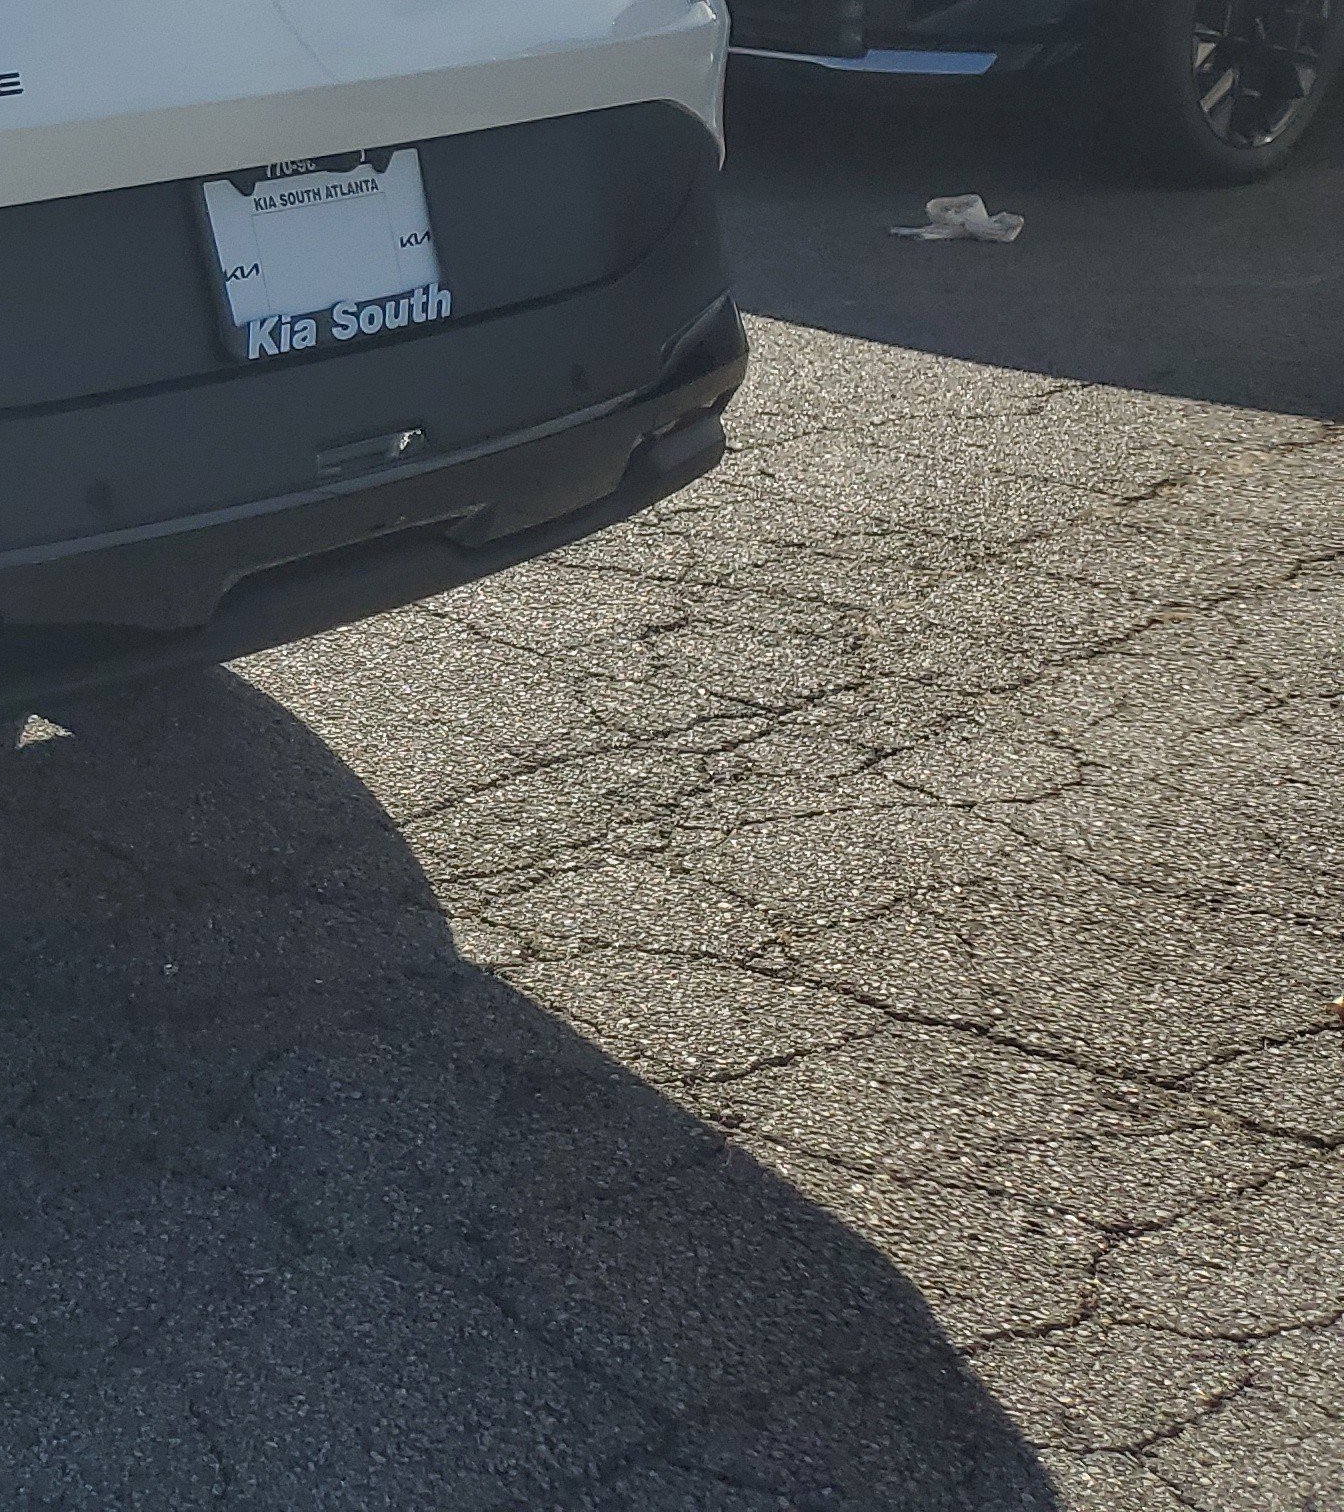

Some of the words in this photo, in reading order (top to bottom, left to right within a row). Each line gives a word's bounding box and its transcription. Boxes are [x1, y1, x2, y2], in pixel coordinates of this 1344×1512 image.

[253, 195, 277, 212] KIA
[279, 187, 322, 207] SOUTH
[325, 178, 380, 200] ATLANTA
[248, 314, 317, 360] Kia
[331, 283, 452, 341] South
